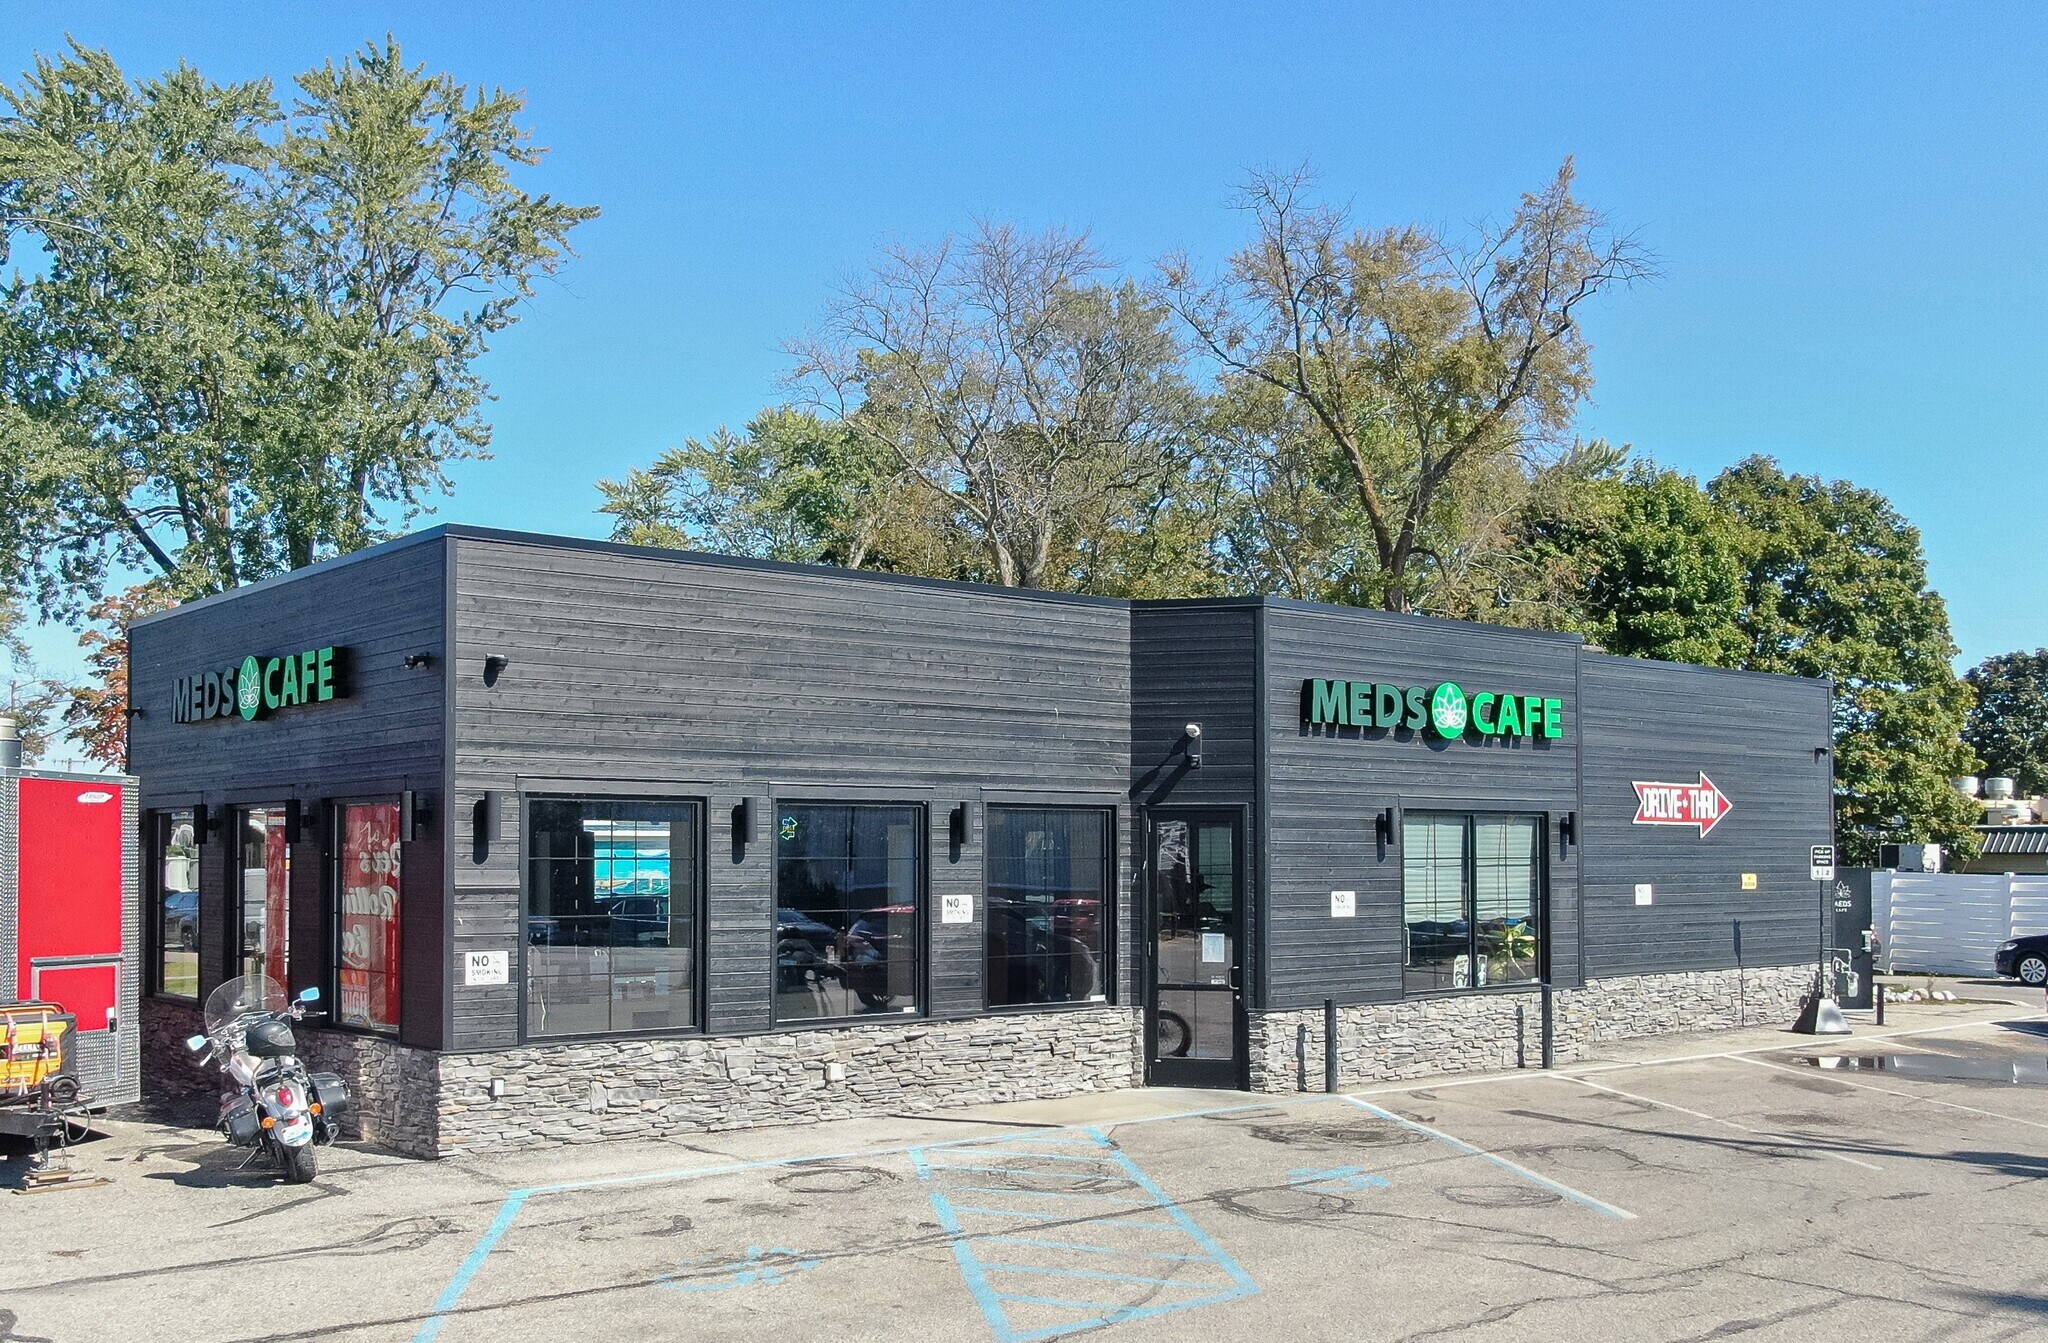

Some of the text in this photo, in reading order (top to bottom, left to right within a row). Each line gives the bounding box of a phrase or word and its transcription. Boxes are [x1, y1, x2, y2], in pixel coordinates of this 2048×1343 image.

[172, 646, 333, 724] MEDS CAFE
[1311, 678, 1563, 739] MEDS CAFE
[1643, 787, 1719, 820] DRIVE THRU
[946, 898, 960, 908] NO
[1335, 894, 1345, 904] NO
[472, 955, 489, 966] NO
